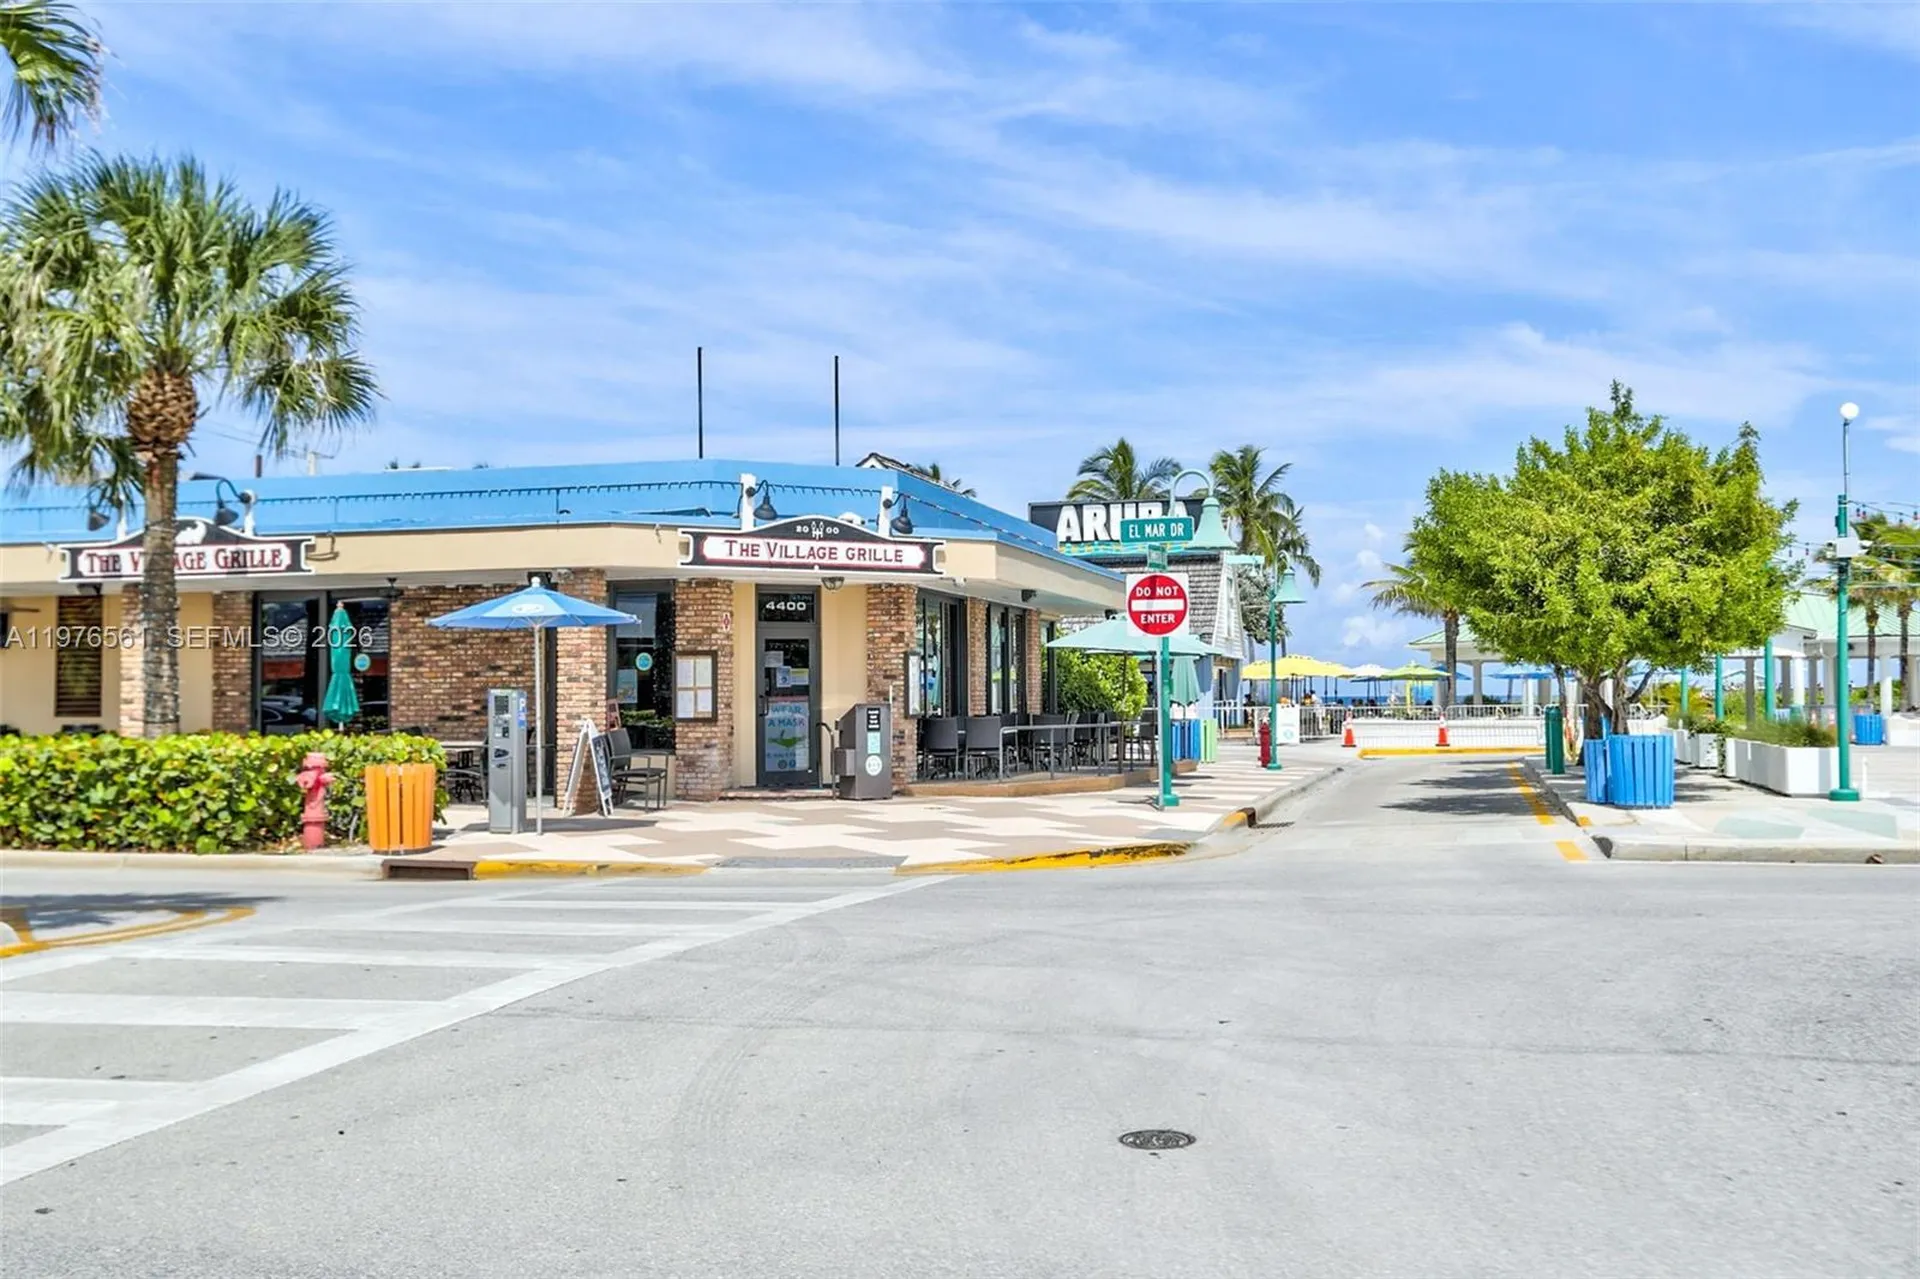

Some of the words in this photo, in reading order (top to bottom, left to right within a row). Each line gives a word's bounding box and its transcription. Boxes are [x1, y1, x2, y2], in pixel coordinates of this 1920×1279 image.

[826, 526, 840, 535] 00
[1129, 524, 1140, 538] EL
[1144, 522, 1165, 538] MAR
[1170, 522, 1184, 537] DR
[724, 540, 760, 557] THE
[766, 541, 838, 560] VILLAGE
[846, 545, 903, 563] GRILLE
[86, 552, 121, 573] THE
[128, 550, 206, 572] VAGE
[215, 548, 283, 569] GRILLE
[1136, 586, 1151, 597] DO
[1155, 585, 1179, 597] NOT
[765, 601, 807, 611] 4400
[1140, 613, 1176, 624] ENTER
